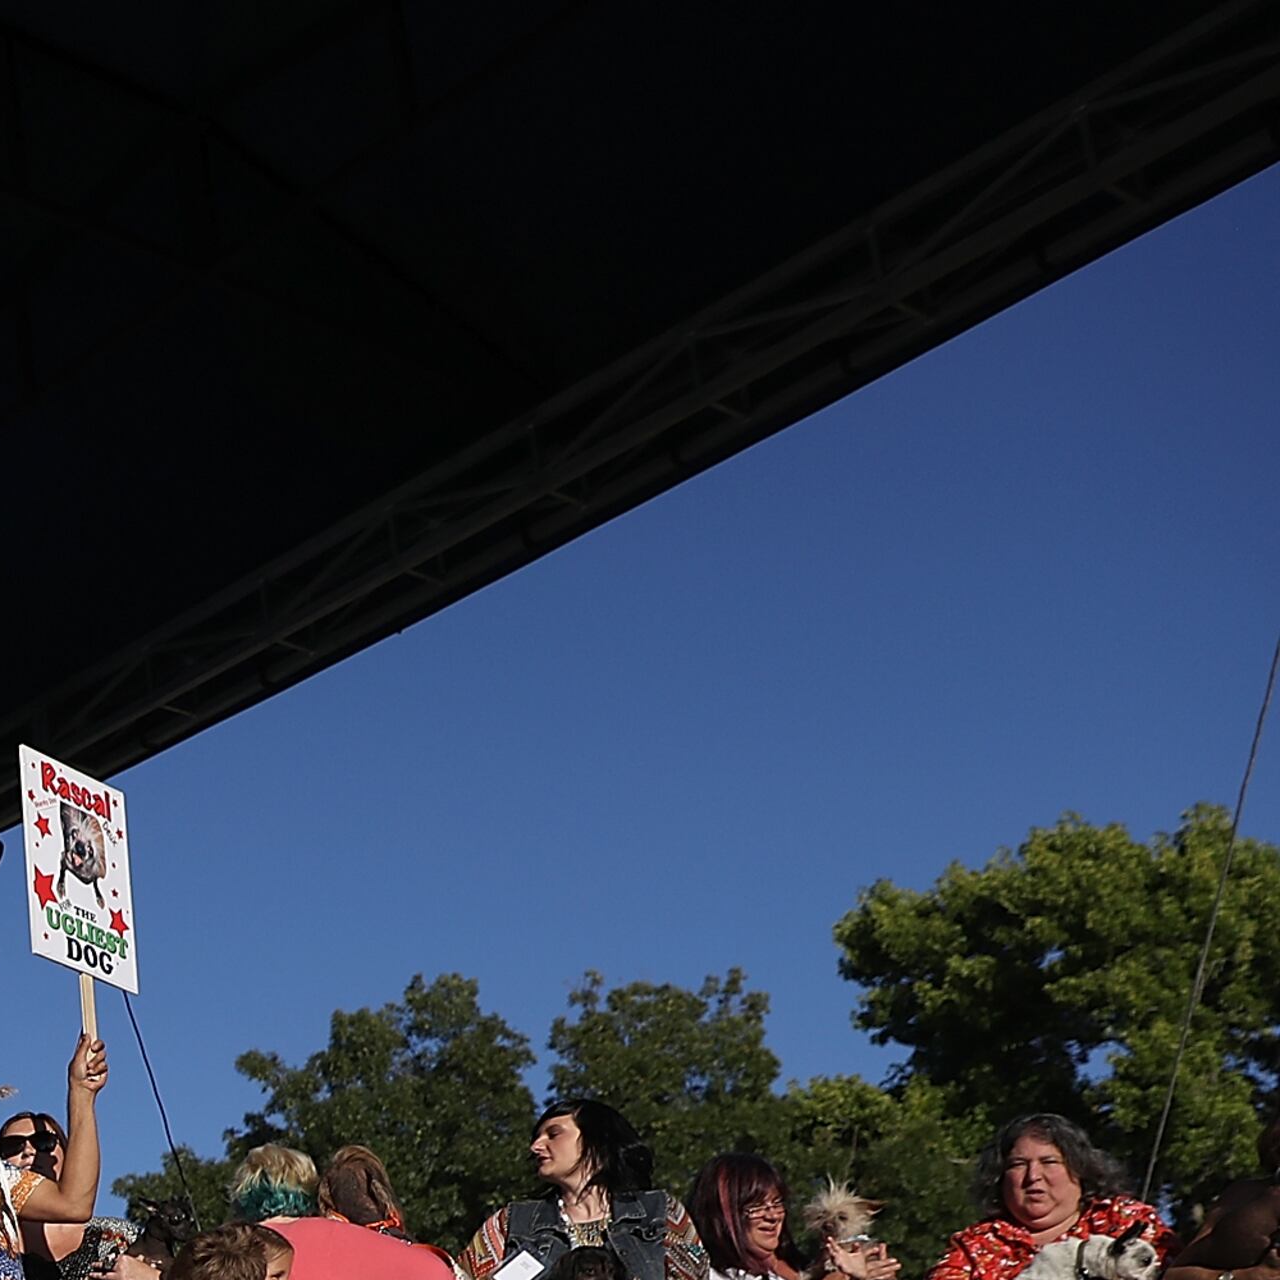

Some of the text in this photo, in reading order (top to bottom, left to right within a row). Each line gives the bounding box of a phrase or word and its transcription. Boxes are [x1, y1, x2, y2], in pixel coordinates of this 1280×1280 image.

[41, 761, 112, 822] Rascal
[46, 907, 128, 959] UGLIEST
[74, 906, 97, 923] THE
[66, 937, 114, 975] DOG
